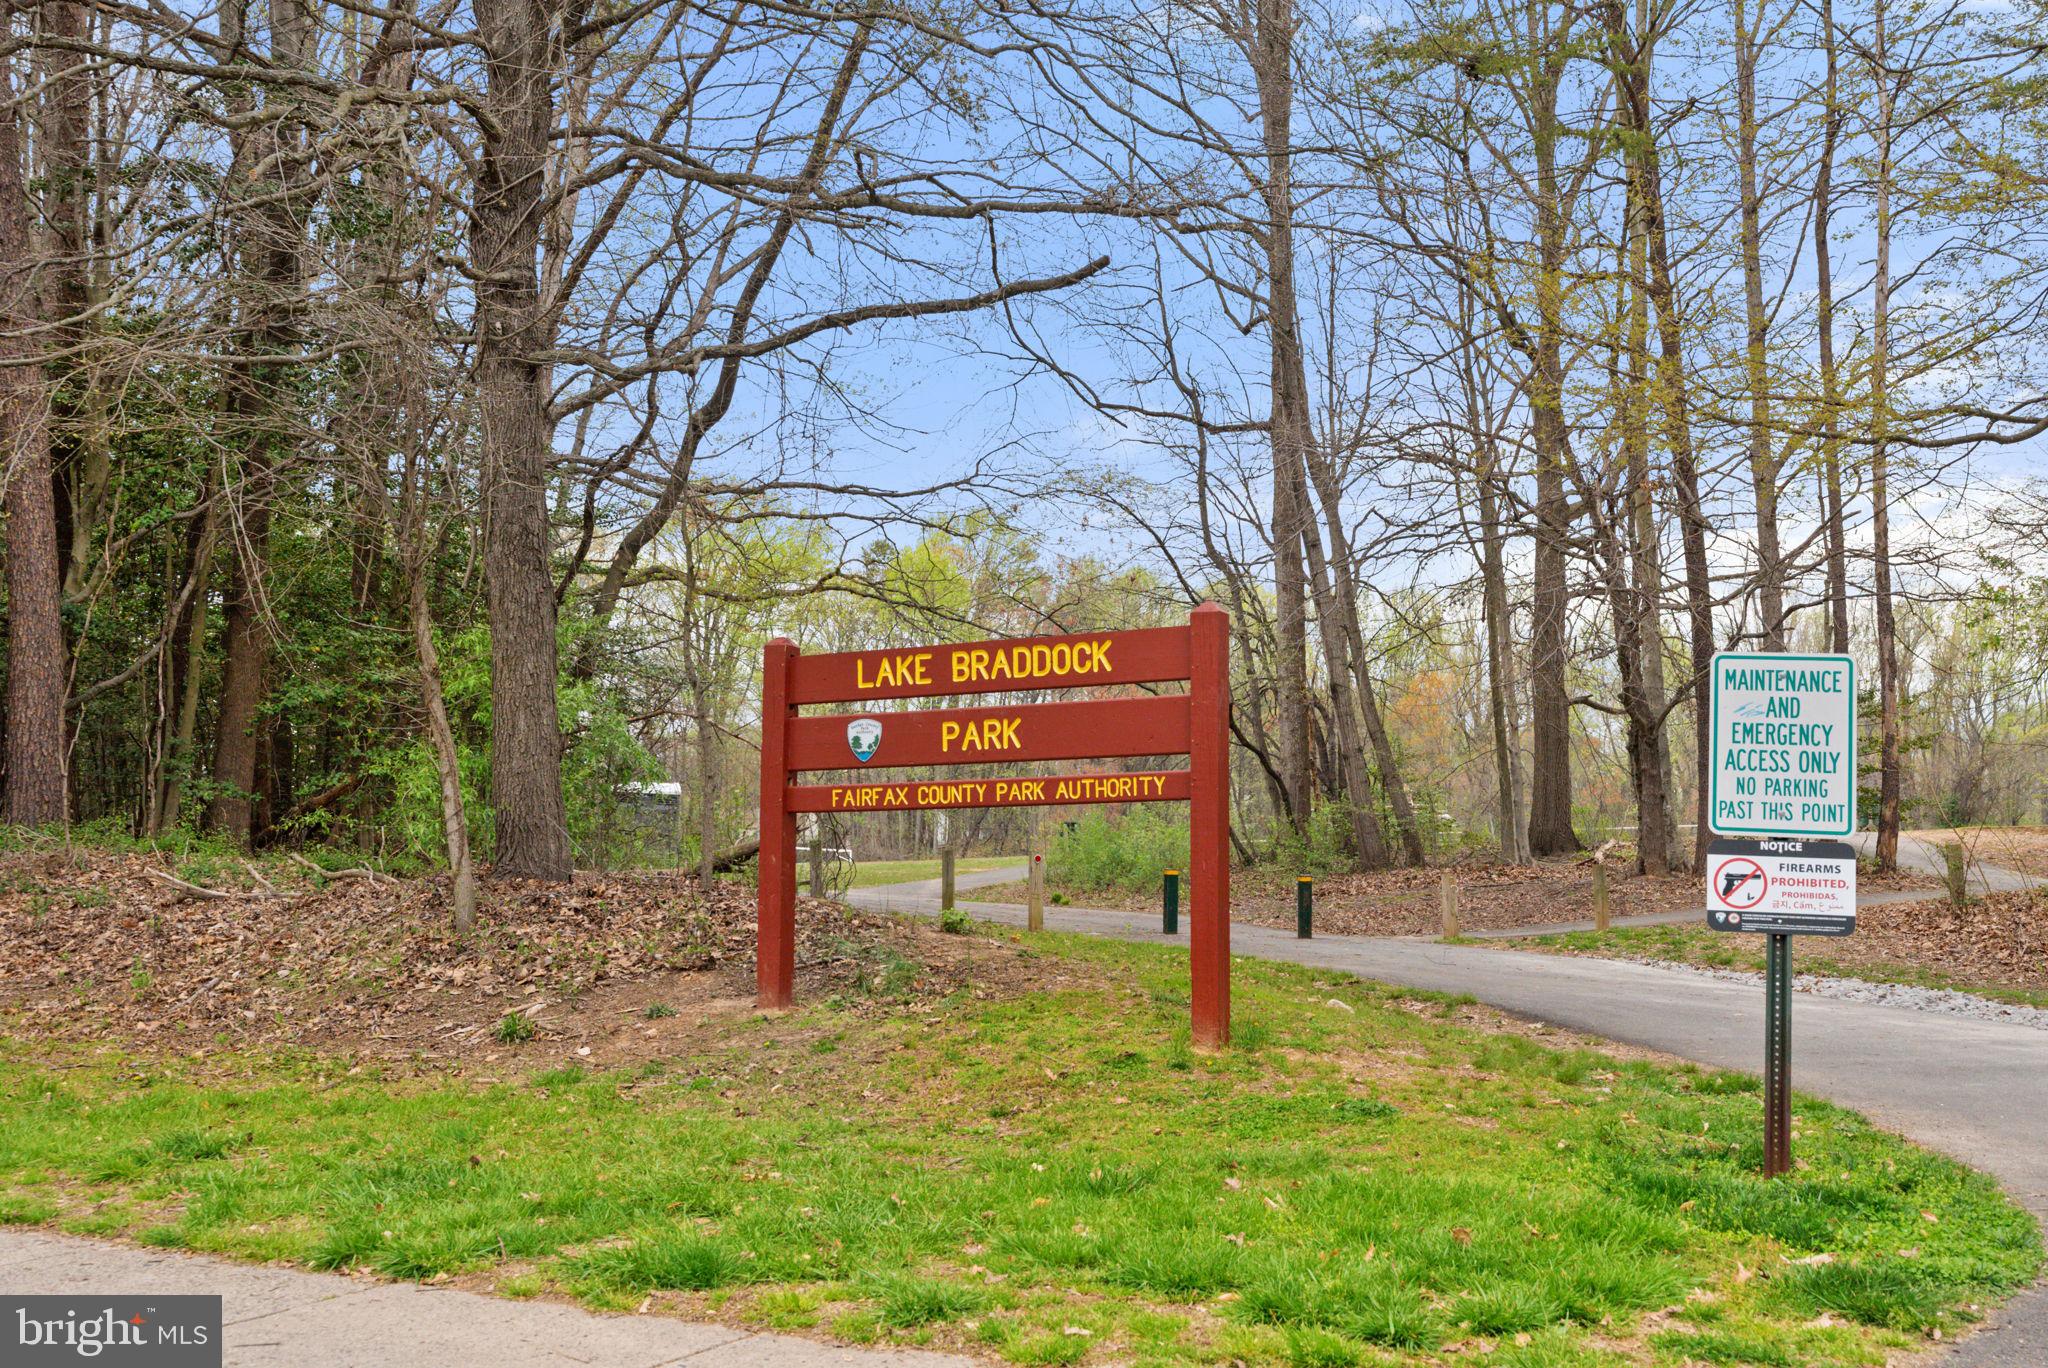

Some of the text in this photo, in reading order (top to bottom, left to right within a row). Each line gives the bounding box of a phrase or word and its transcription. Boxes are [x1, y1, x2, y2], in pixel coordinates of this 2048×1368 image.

[857, 639, 1112, 688] LAKE BRADDOCK
[1725, 668, 1842, 693] MAINTENANCE
[1765, 696, 1800, 719] AND
[942, 718, 1022, 752] PARK
[1731, 722, 1833, 746] EMERGENCY
[1724, 749, 1841, 774] ACCESS ONLY
[832, 776, 1166, 807] FAIRFAX COUNTY PARK AUTHORITY
[1736, 777, 1828, 798] NO PARKING
[1719, 800, 1845, 823] PAST THIS POINT
[1760, 841, 1803, 853] NOTICE
[1779, 863, 1842, 874] FIREARMS
[1771, 877, 1849, 890] PROHIBITED,
[1781, 891, 1838, 901] PROHIBIDAS,
